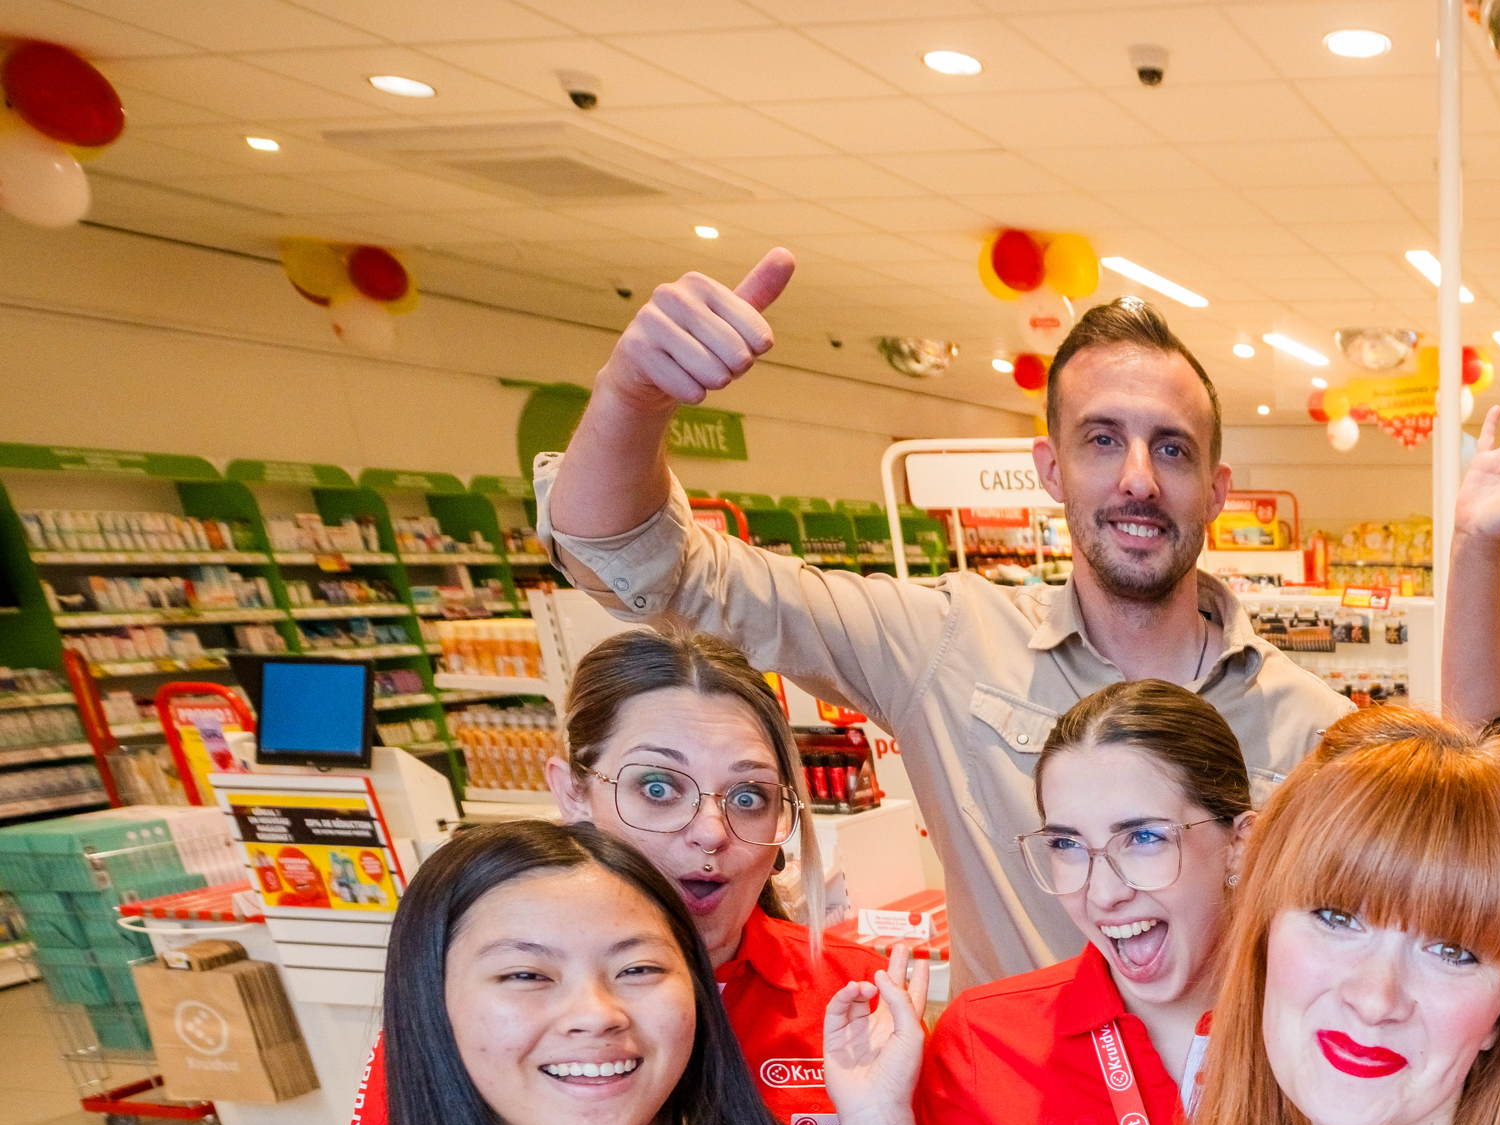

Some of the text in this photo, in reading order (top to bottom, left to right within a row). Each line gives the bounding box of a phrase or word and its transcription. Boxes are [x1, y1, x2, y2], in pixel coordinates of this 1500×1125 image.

[670, 420, 728, 451] SANTÉ
[980, 470, 1043, 490] CAISS
[1099, 1024, 1124, 1070] Kruidv
